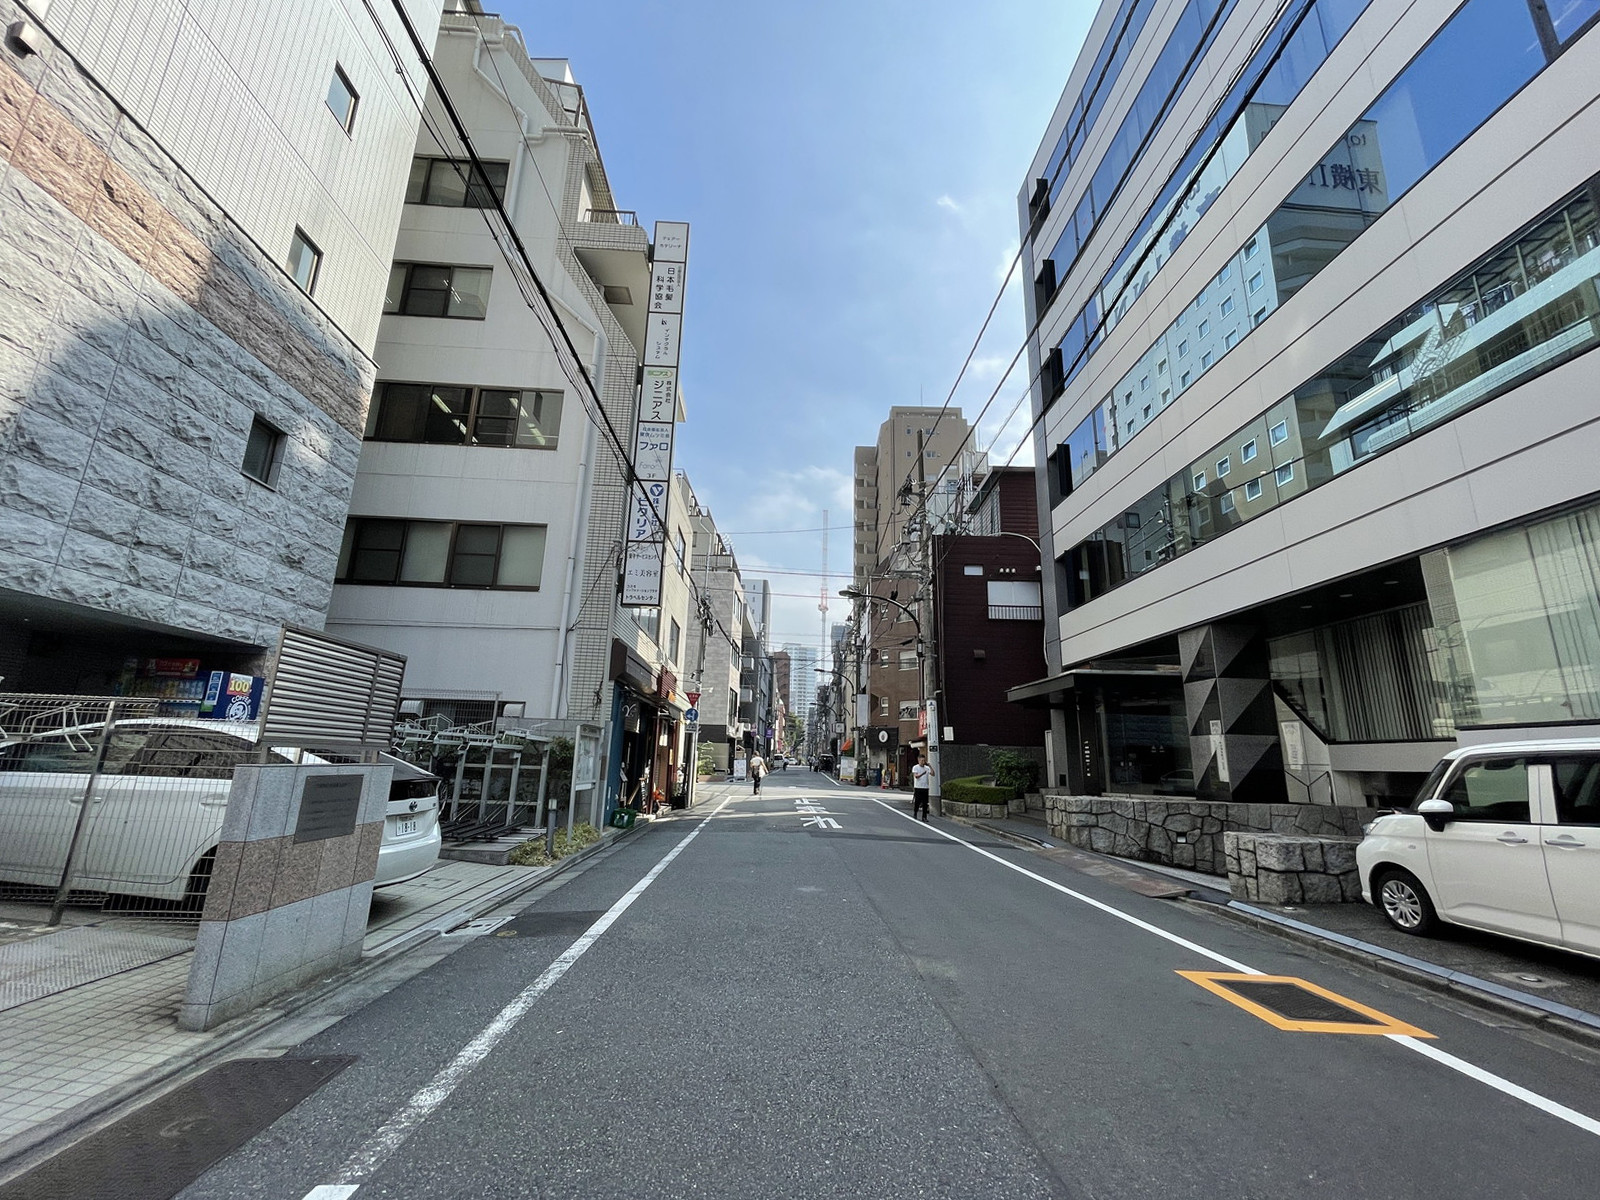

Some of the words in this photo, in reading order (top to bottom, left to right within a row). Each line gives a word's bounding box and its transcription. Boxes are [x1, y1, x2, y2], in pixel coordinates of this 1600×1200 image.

[654, 275, 664, 310] 科学協会
[665, 267, 675, 301] 日本毛髪
[650, 380, 665, 421] ジニアス
[639, 441, 669, 451] ファロ
[627, 569, 660, 578] エミ美容室
[229, 680, 249, 693] 100
[793, 798, 843, 829] 止まれ
